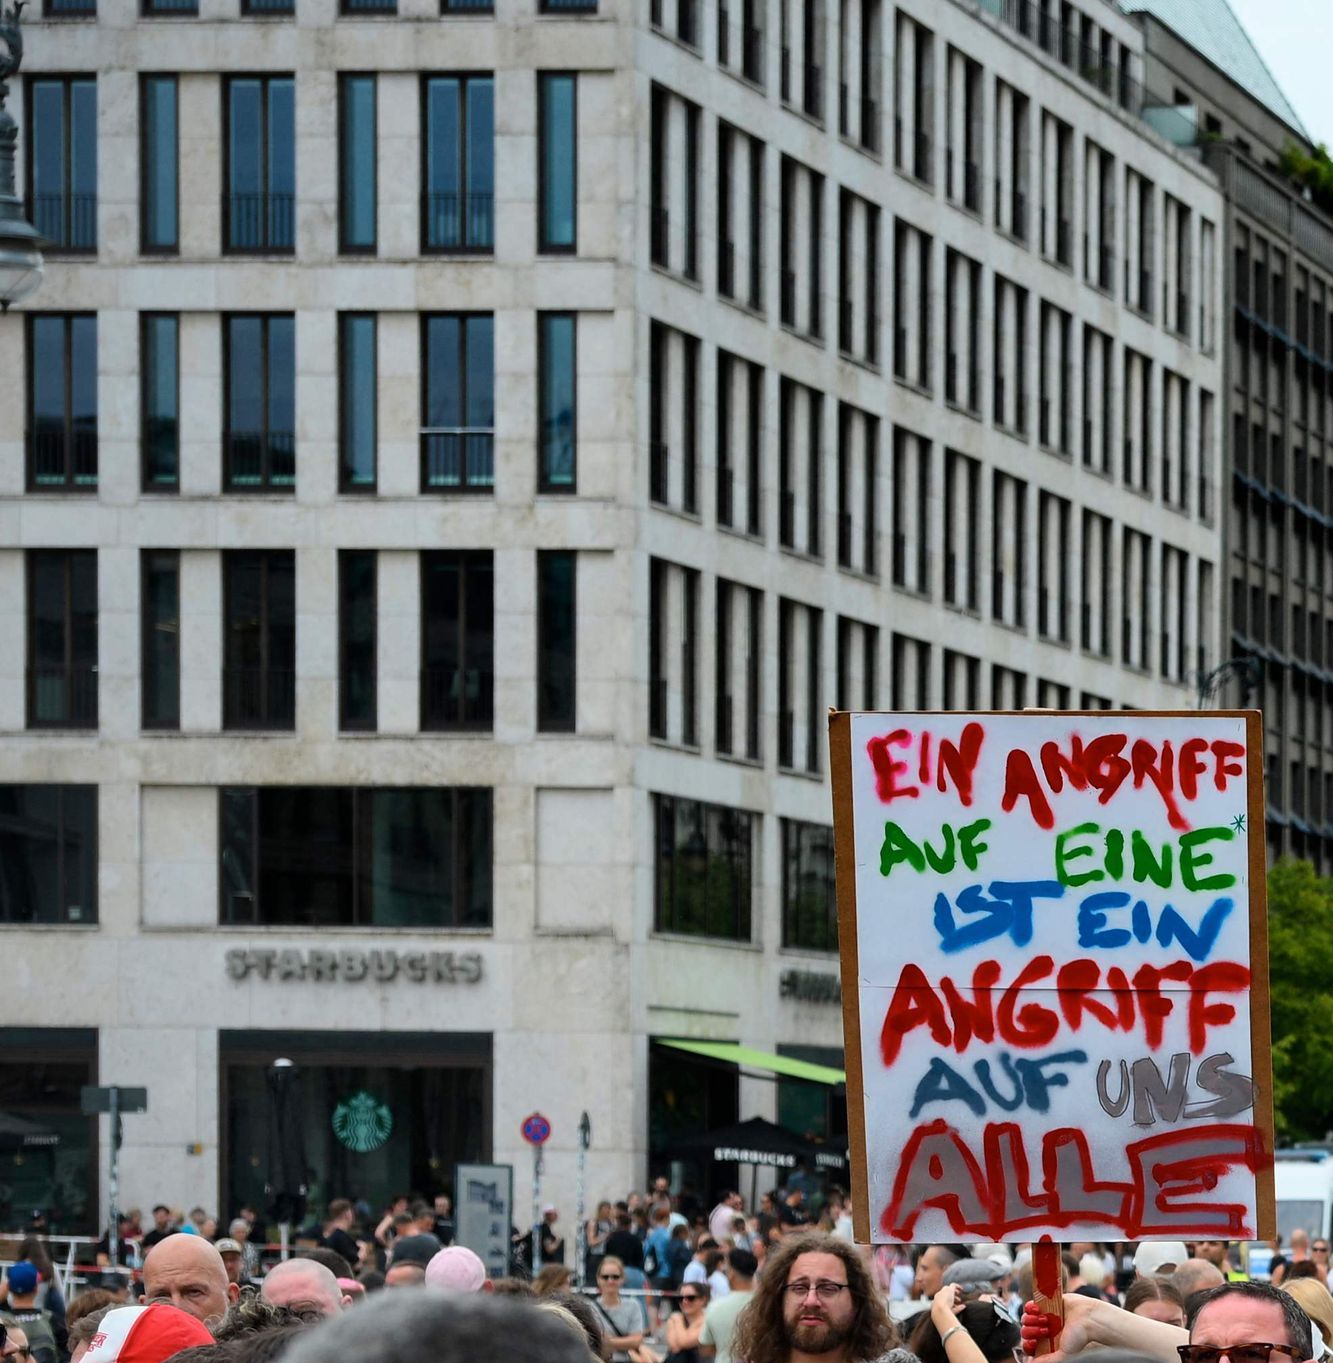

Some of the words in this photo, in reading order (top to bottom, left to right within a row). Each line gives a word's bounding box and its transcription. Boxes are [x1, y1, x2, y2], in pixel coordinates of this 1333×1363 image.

[867, 722, 984, 808] EIN
[1001, 732, 1245, 832] ANGRIFF
[879, 818, 992, 877] AUF
[933, 879, 1066, 954] IST
[1076, 890, 1235, 962] EIN
[224, 948, 483, 985] STARBUCKS
[880, 955, 1251, 1068] ANGRIFF
[908, 1049, 1088, 1118] AUF
[1096, 1052, 1259, 1126] UNS
[714, 1146, 796, 1168] STARBUCKS
[880, 1117, 1274, 1242] ALLE
